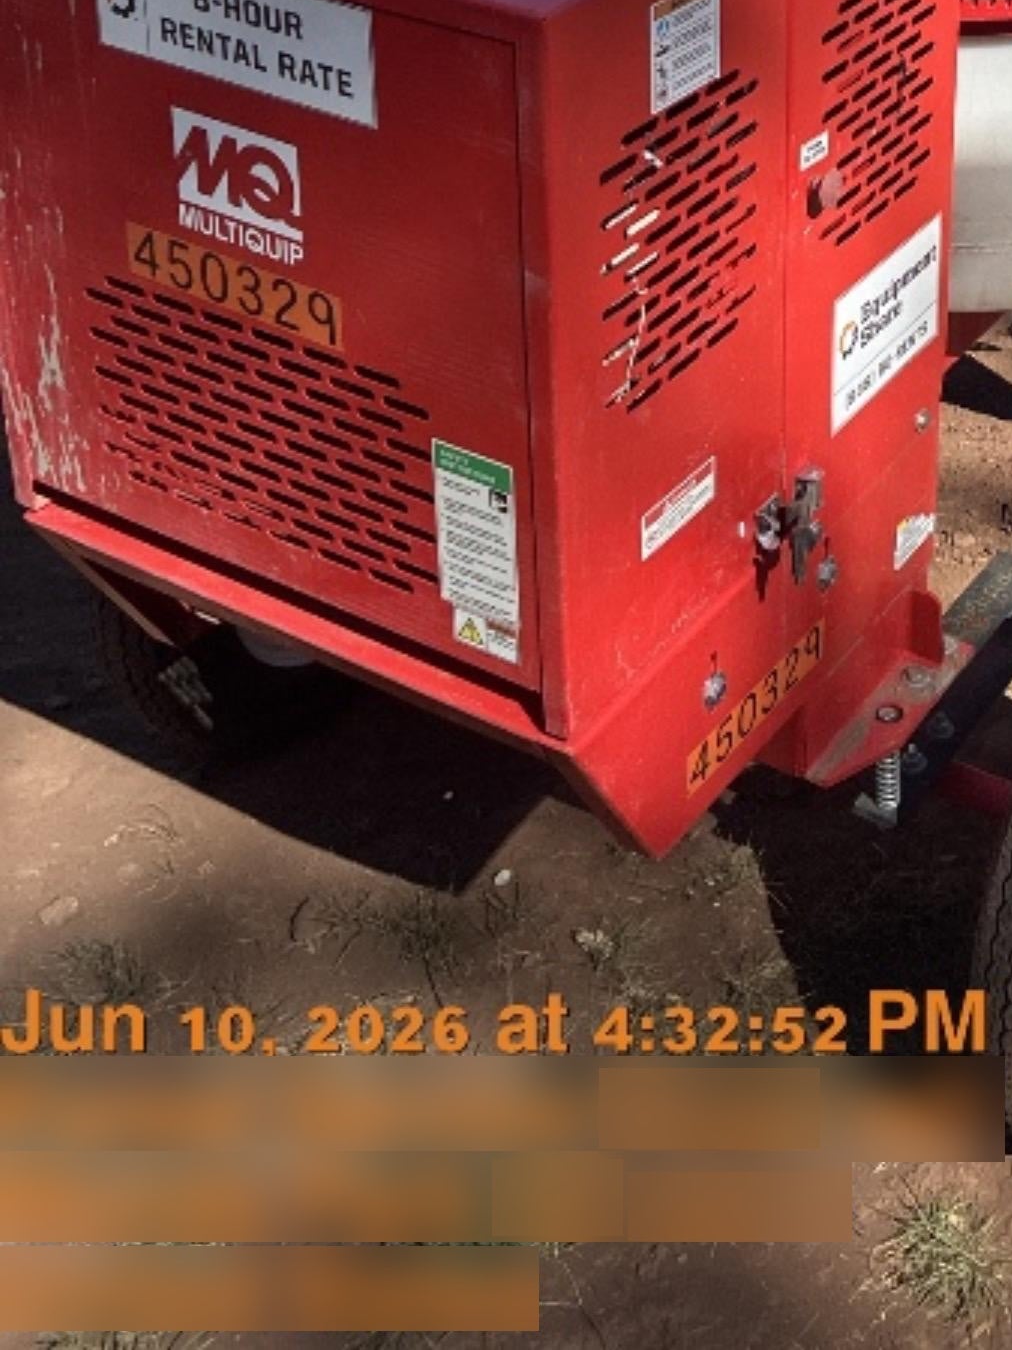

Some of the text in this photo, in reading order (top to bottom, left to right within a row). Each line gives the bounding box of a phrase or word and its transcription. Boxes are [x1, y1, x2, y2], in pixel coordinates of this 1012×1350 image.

[160, 17, 354, 98] RENTAL RATE
[178, 203, 304, 266] MULTIQUIP
[133, 230, 337, 346] 450329
[689, 626, 820, 784] 450329
